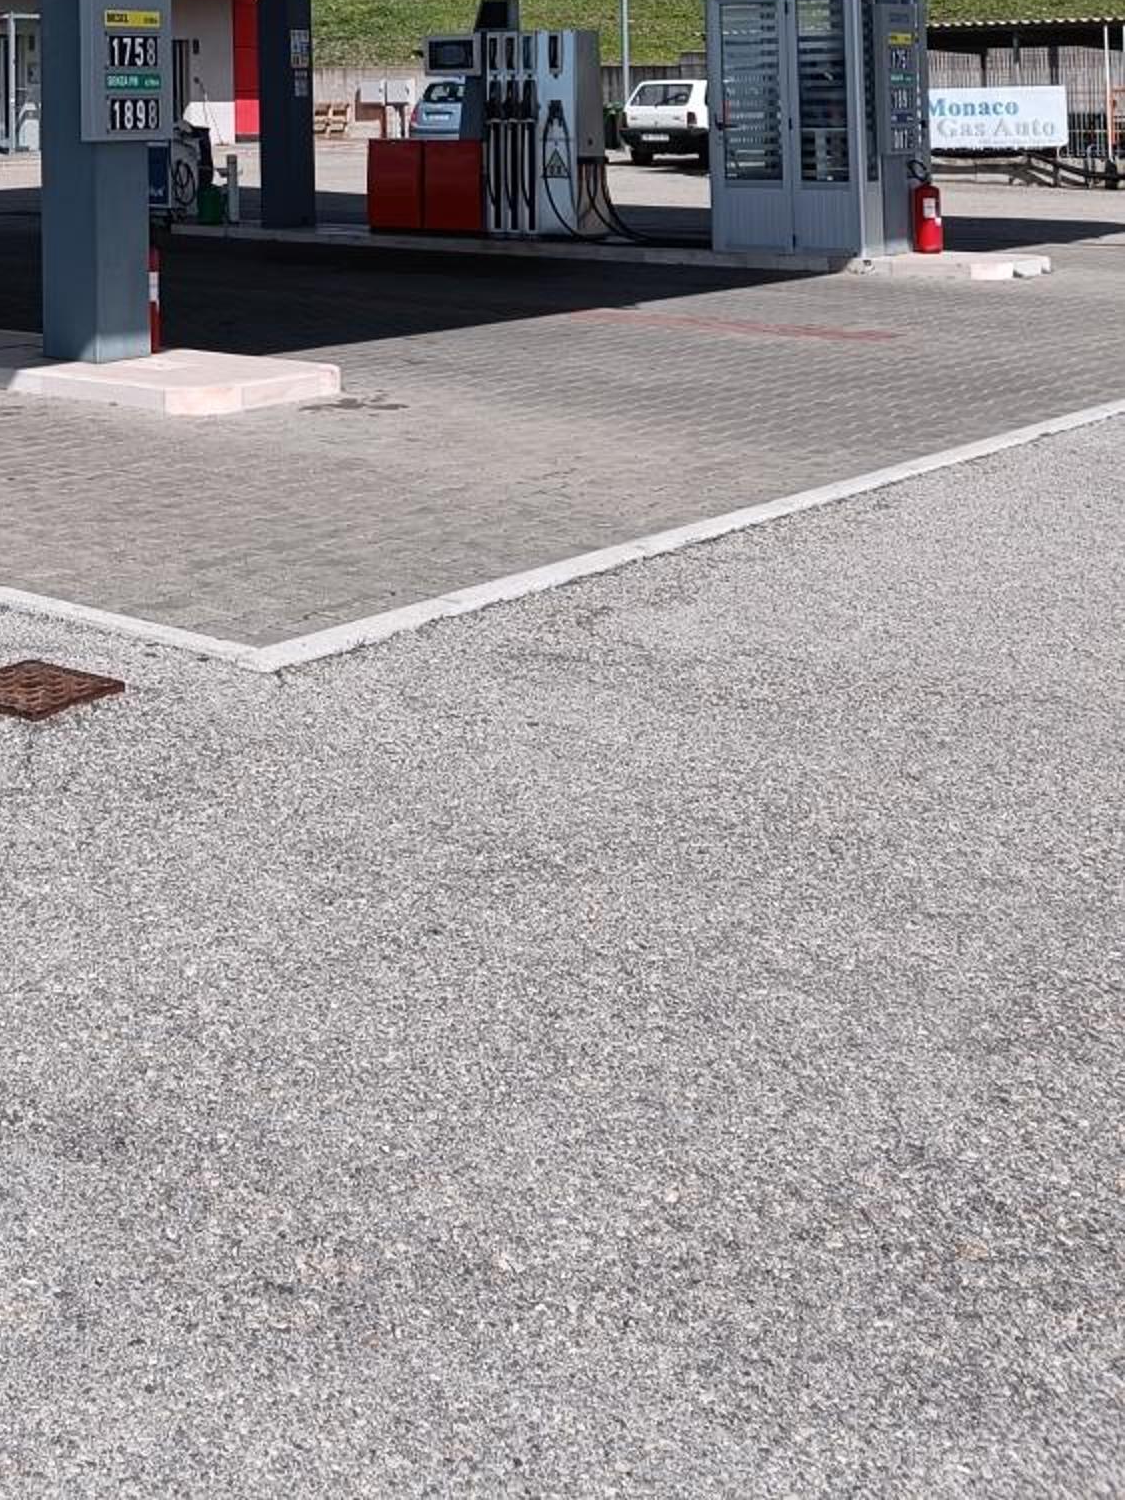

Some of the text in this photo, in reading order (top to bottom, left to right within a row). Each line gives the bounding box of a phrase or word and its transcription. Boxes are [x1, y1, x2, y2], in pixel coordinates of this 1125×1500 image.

[112, 37, 156, 66] 1758
[113, 99, 157, 129] 1898
[929, 98, 1019, 116] Monaco
[937, 117, 1055, 137] Gas Auto
